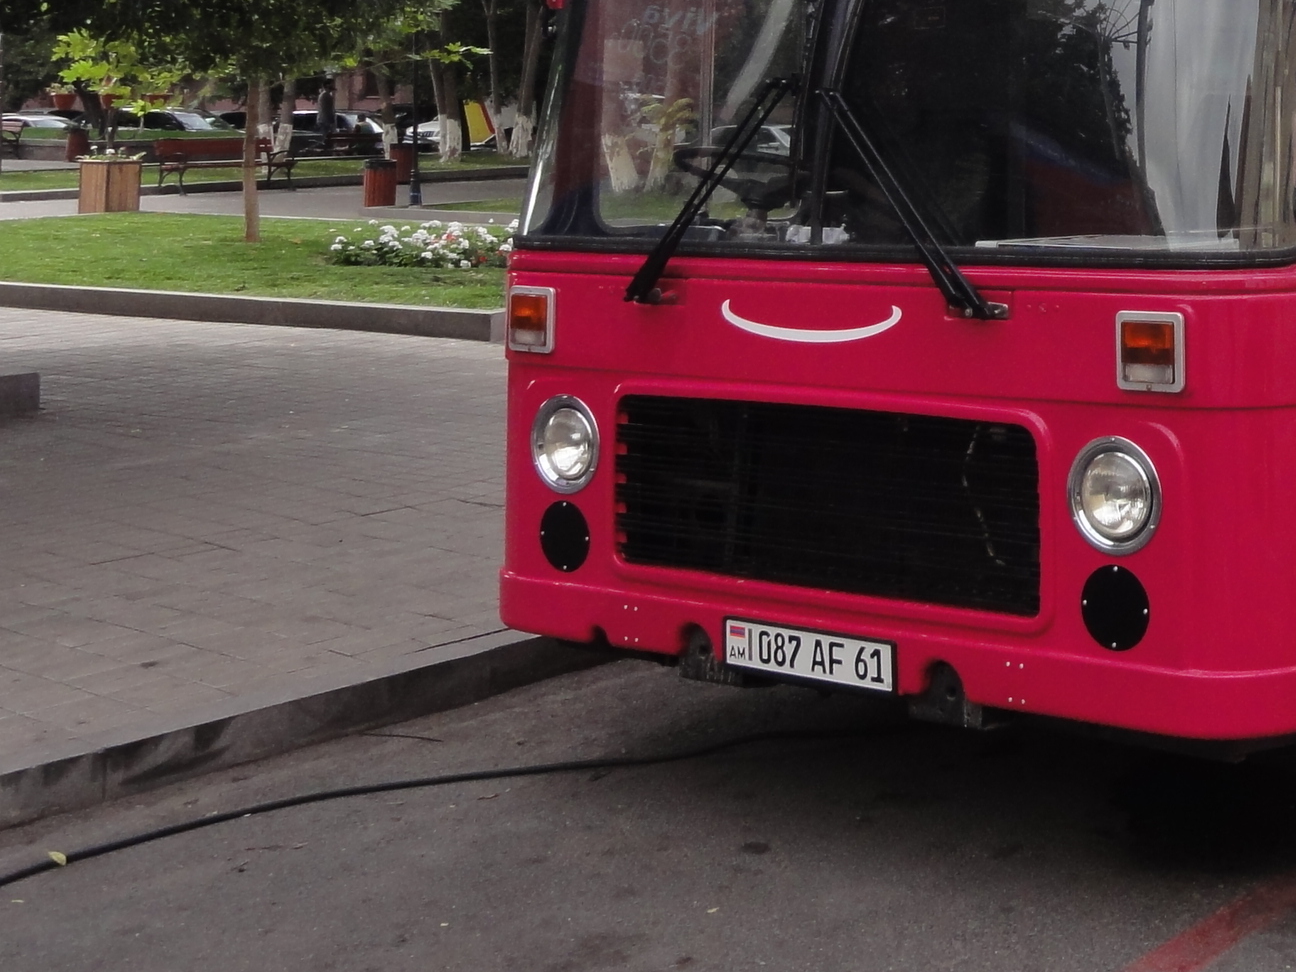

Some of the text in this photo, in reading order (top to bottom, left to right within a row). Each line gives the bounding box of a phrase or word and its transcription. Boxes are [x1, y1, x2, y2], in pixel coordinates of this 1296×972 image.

[729, 644, 746, 660] AM
[758, 630, 884, 684] 087 AF 61
